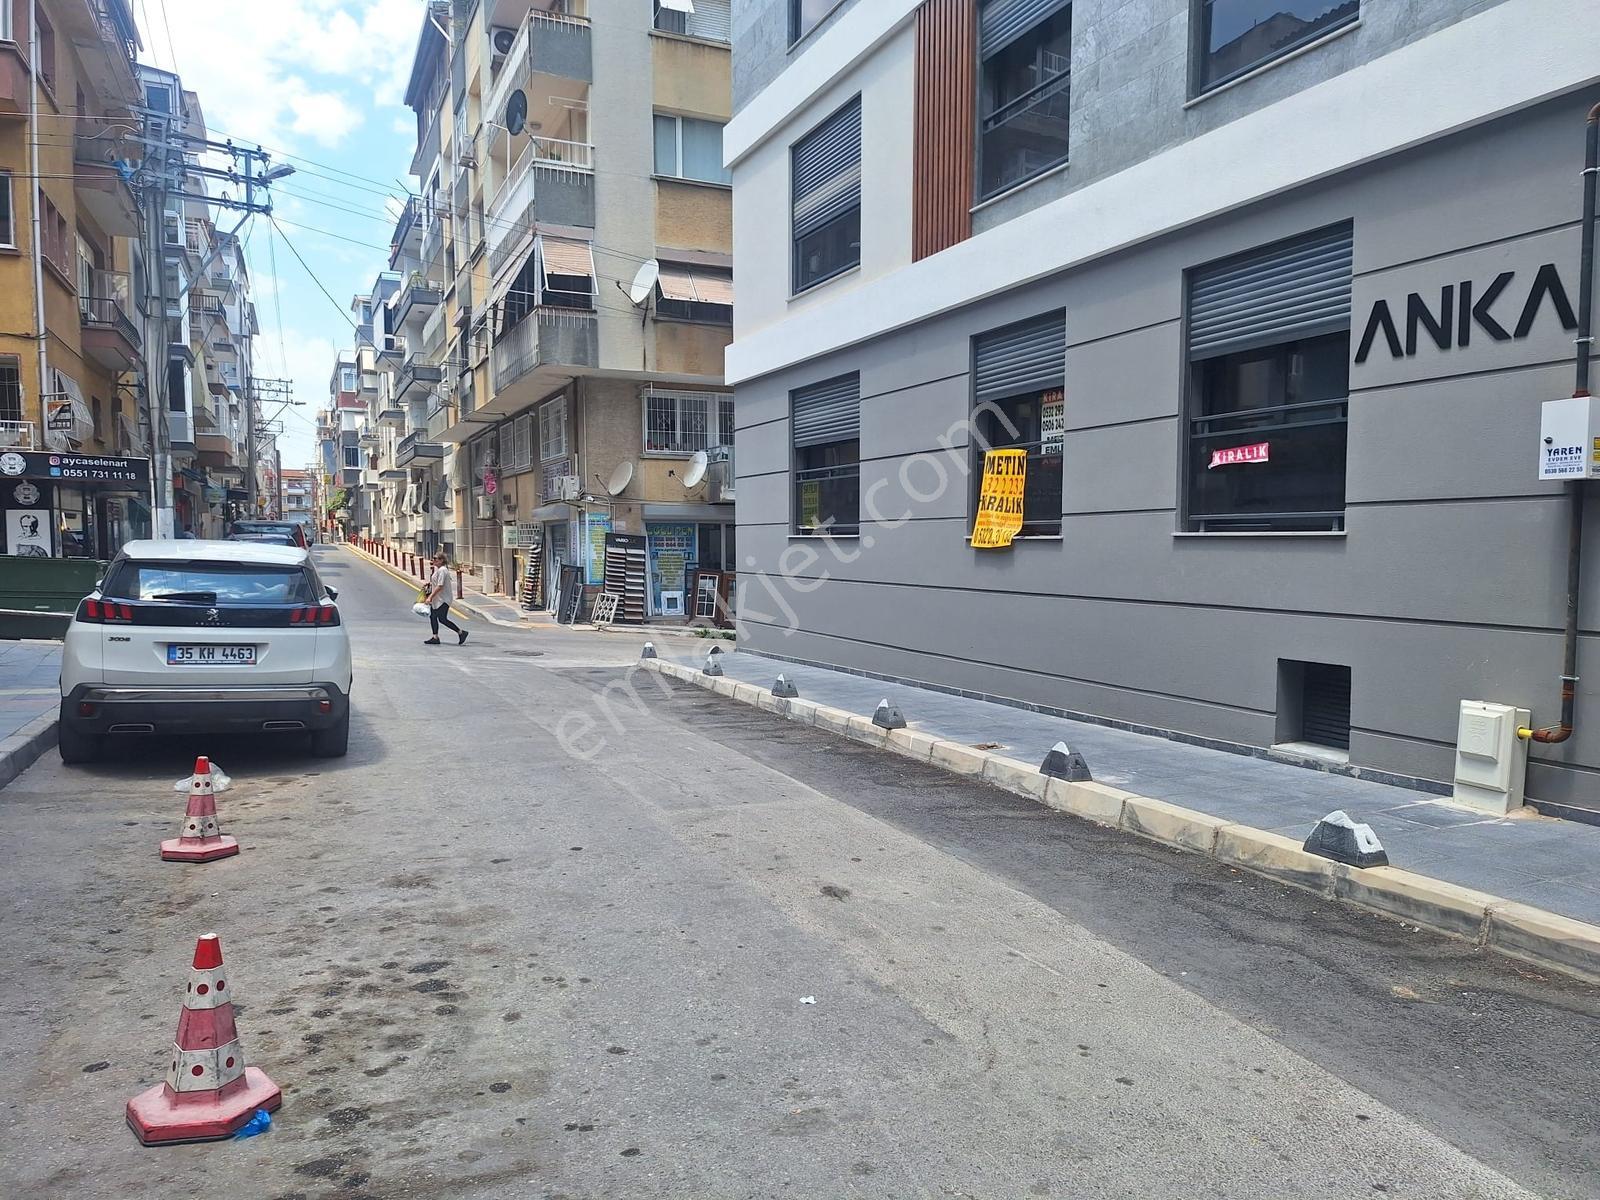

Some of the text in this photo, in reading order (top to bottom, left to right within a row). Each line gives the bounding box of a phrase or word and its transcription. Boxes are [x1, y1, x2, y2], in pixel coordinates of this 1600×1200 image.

[1354, 263, 1579, 363] ANKA
[1547, 446, 1582, 457] YAREN
[62, 456, 128, 467] aycaselenart
[63, 469, 136, 480] 0551 731 11 18
[177, 647, 253, 660] 35 KH 4463
